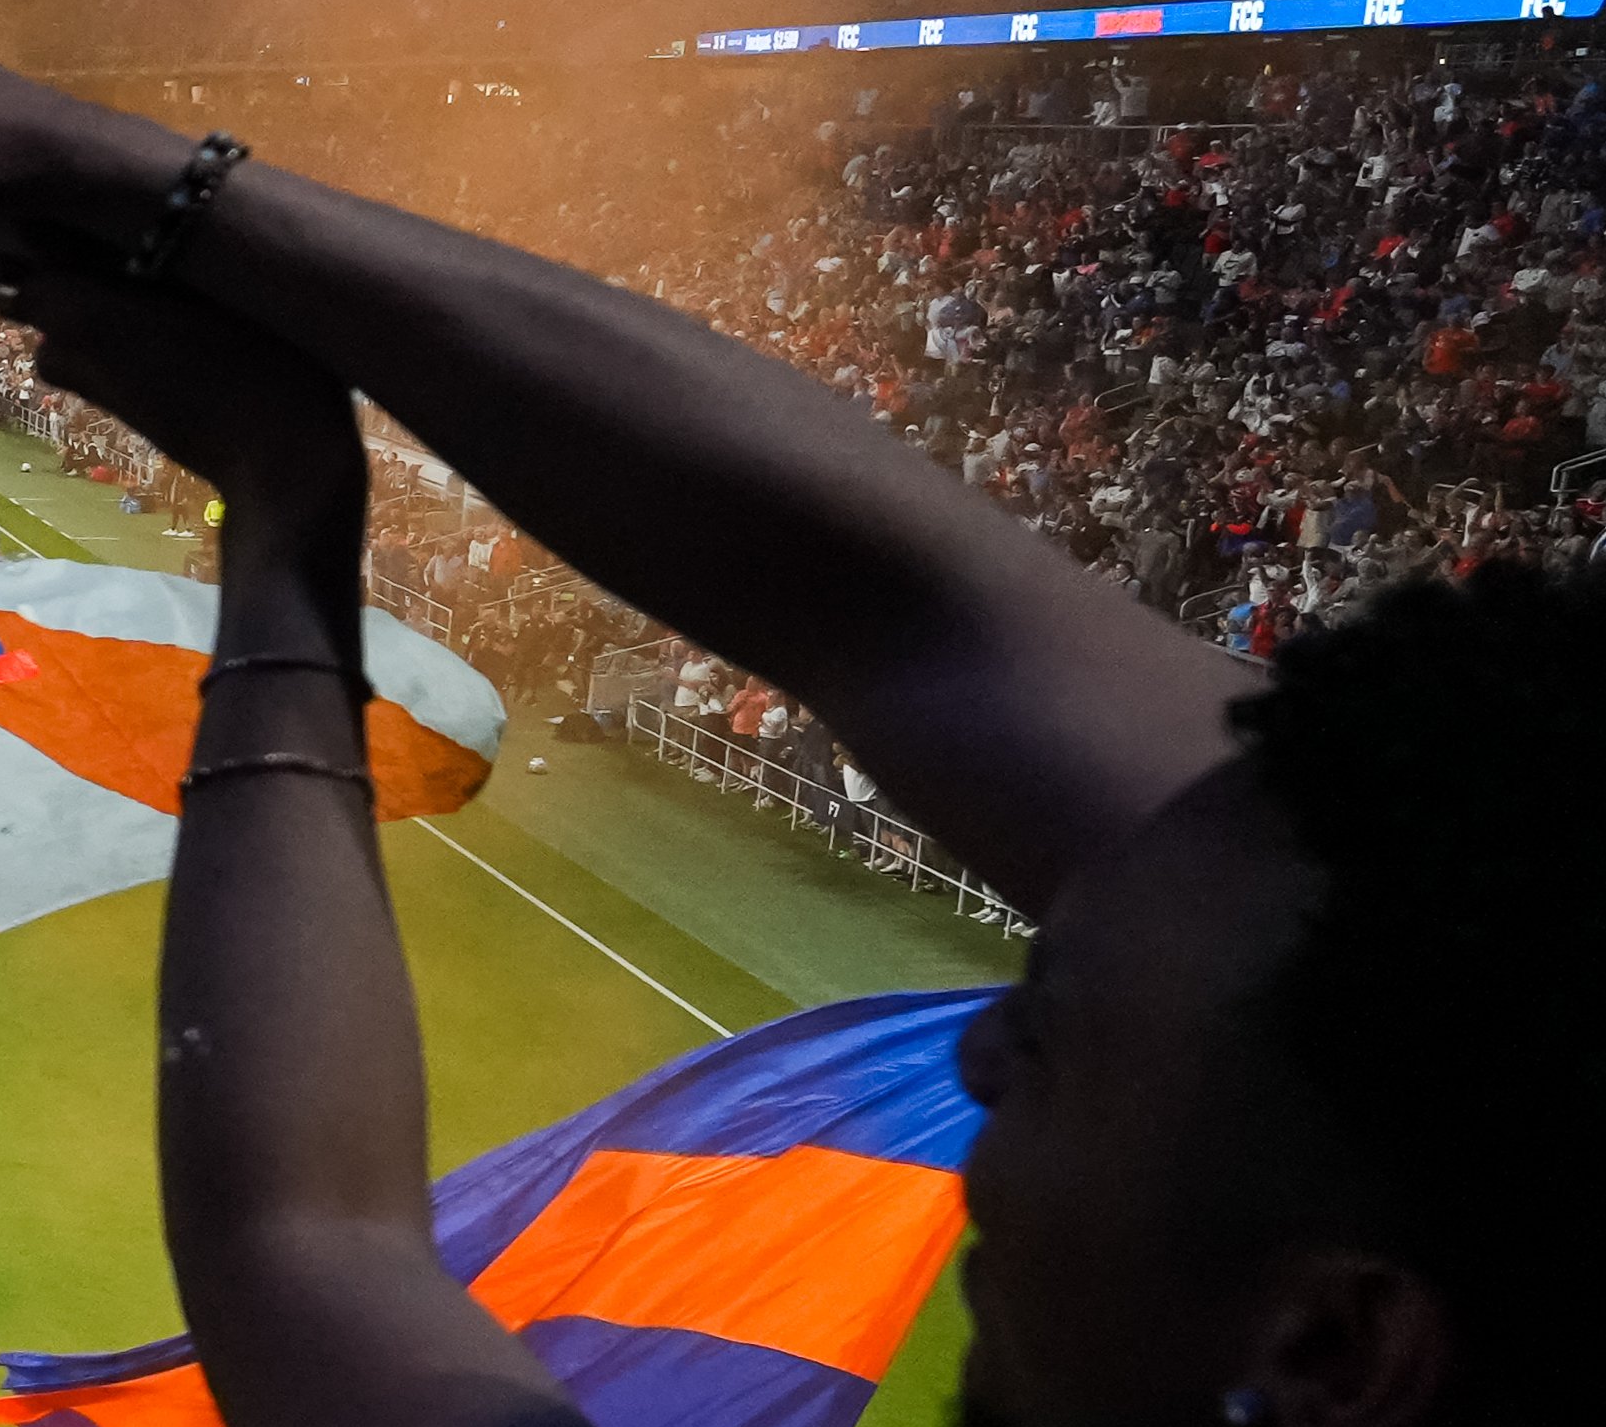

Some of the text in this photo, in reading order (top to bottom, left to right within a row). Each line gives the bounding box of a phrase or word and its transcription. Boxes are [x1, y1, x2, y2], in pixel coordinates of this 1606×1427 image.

[1010, 14, 1038, 42] FCC
[1229, 0, 1265, 31] FCC
[838, 24, 861, 49] FCC
[918, 19, 945, 45] FCC
[828, 800, 841, 818] F7
